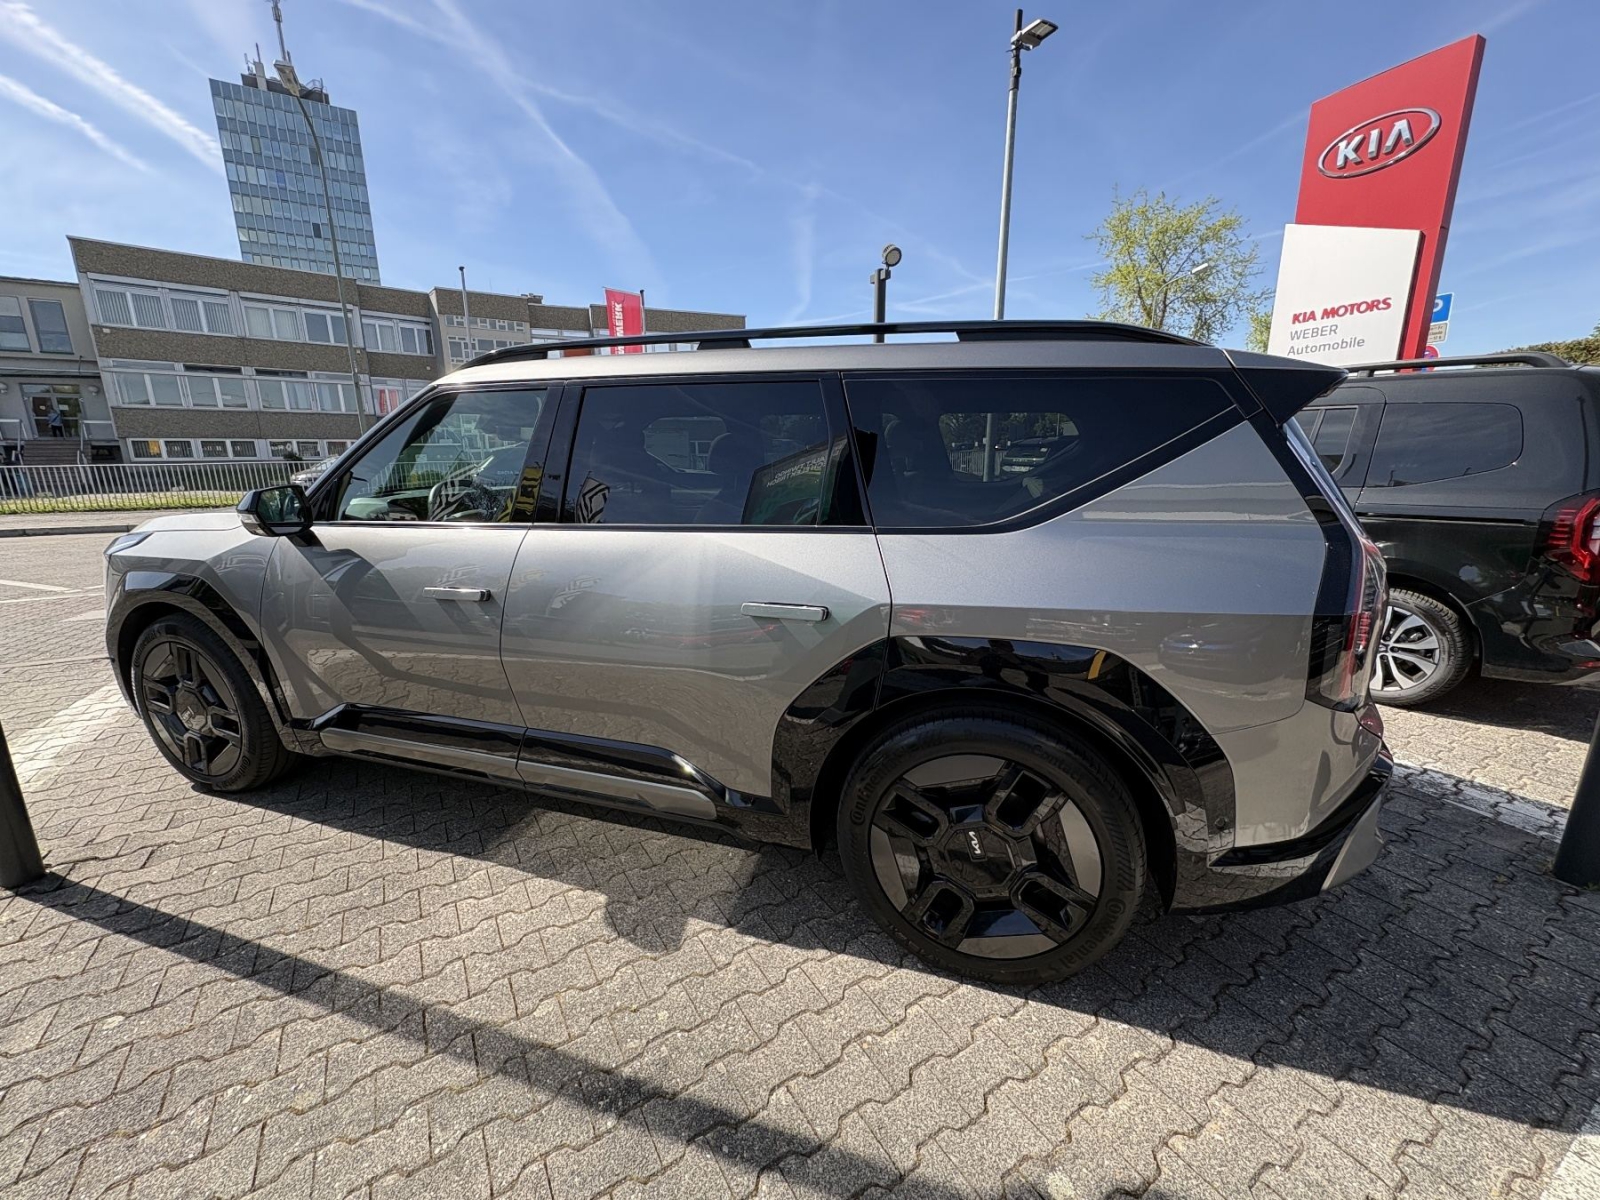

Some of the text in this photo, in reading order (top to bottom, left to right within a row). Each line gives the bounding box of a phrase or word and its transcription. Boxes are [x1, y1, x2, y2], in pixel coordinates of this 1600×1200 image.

[1336, 119, 1414, 169] KIA
[1291, 297, 1392, 325] KIA MOTORS
[1290, 324, 1338, 341] WEBER
[1286, 336, 1365, 356] Automobile
